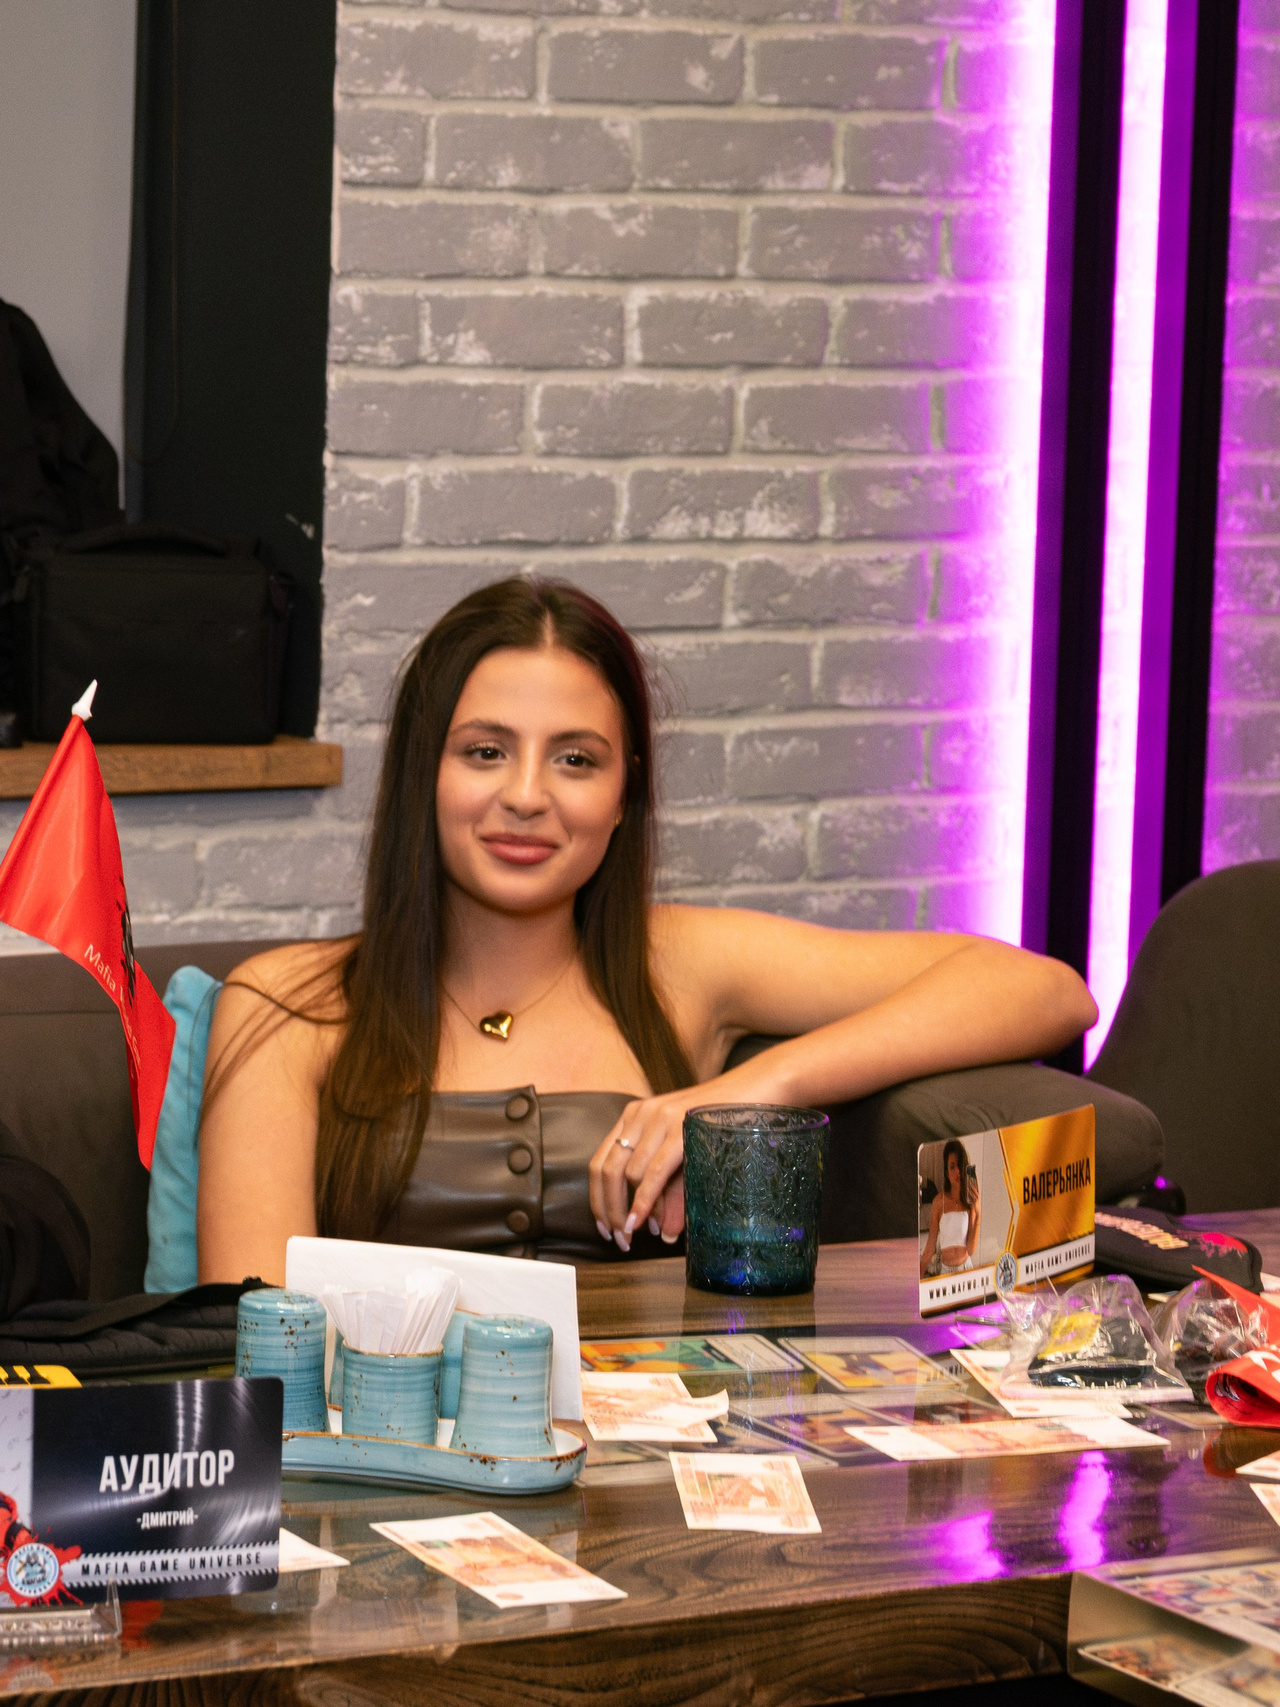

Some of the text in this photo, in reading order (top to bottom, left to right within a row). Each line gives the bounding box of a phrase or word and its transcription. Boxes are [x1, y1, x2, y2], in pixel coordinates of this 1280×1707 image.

[83, 944, 116, 992] Mafia
[1023, 1157, 1091, 1205] ВАЛЕРЬЯНКА
[99, 1449, 235, 1494] АУДИТОР
[81, 1552, 261, 1576] MAFIA GAME UNIVERSE
